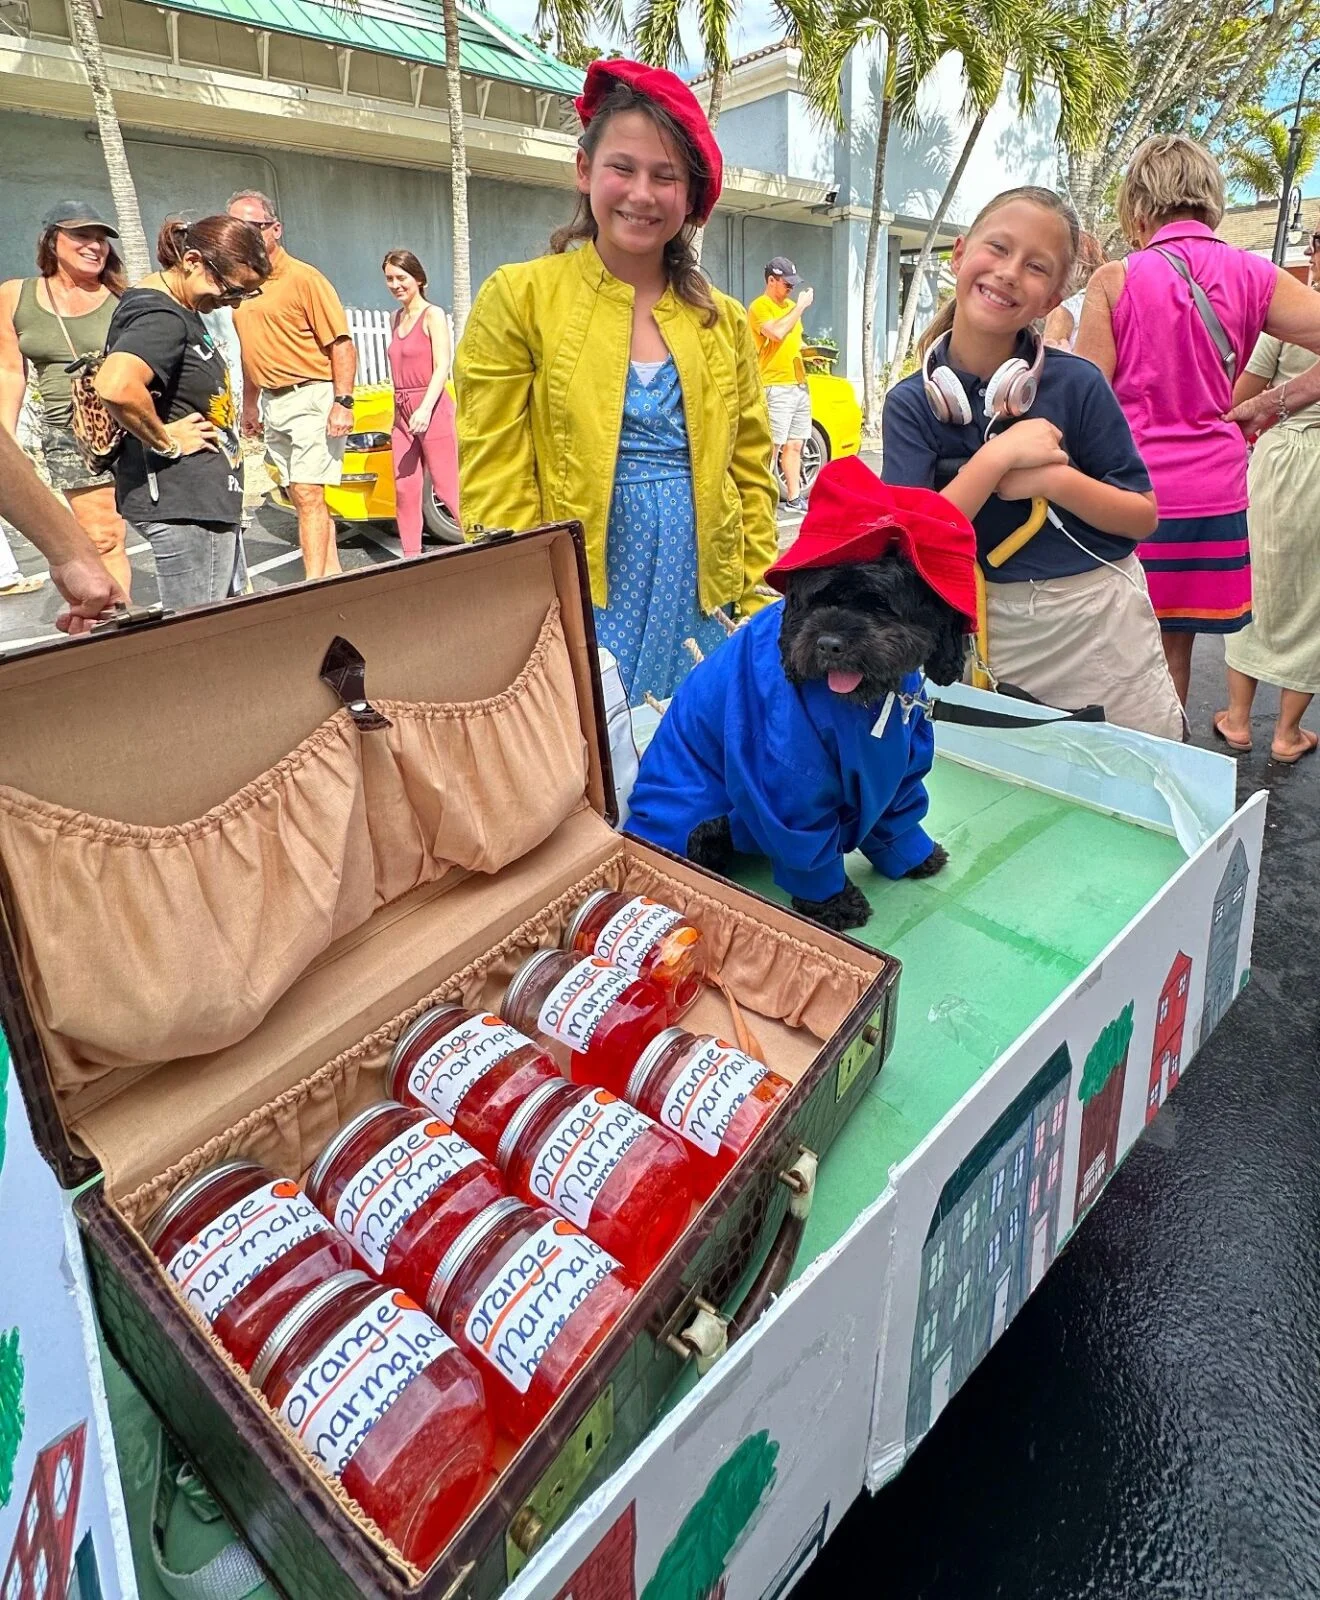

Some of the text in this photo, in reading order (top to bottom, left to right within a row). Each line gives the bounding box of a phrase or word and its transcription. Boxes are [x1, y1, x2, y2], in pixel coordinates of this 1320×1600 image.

[597, 907, 644, 958] orange
[545, 966, 597, 1027] orange
[413, 1029, 480, 1092] orange
[668, 1048, 722, 1127] orange
[340, 1133, 426, 1236] orange
[534, 1104, 601, 1196] orange
[471, 1239, 557, 1345] orange
[287, 1304, 401, 1428] orange
